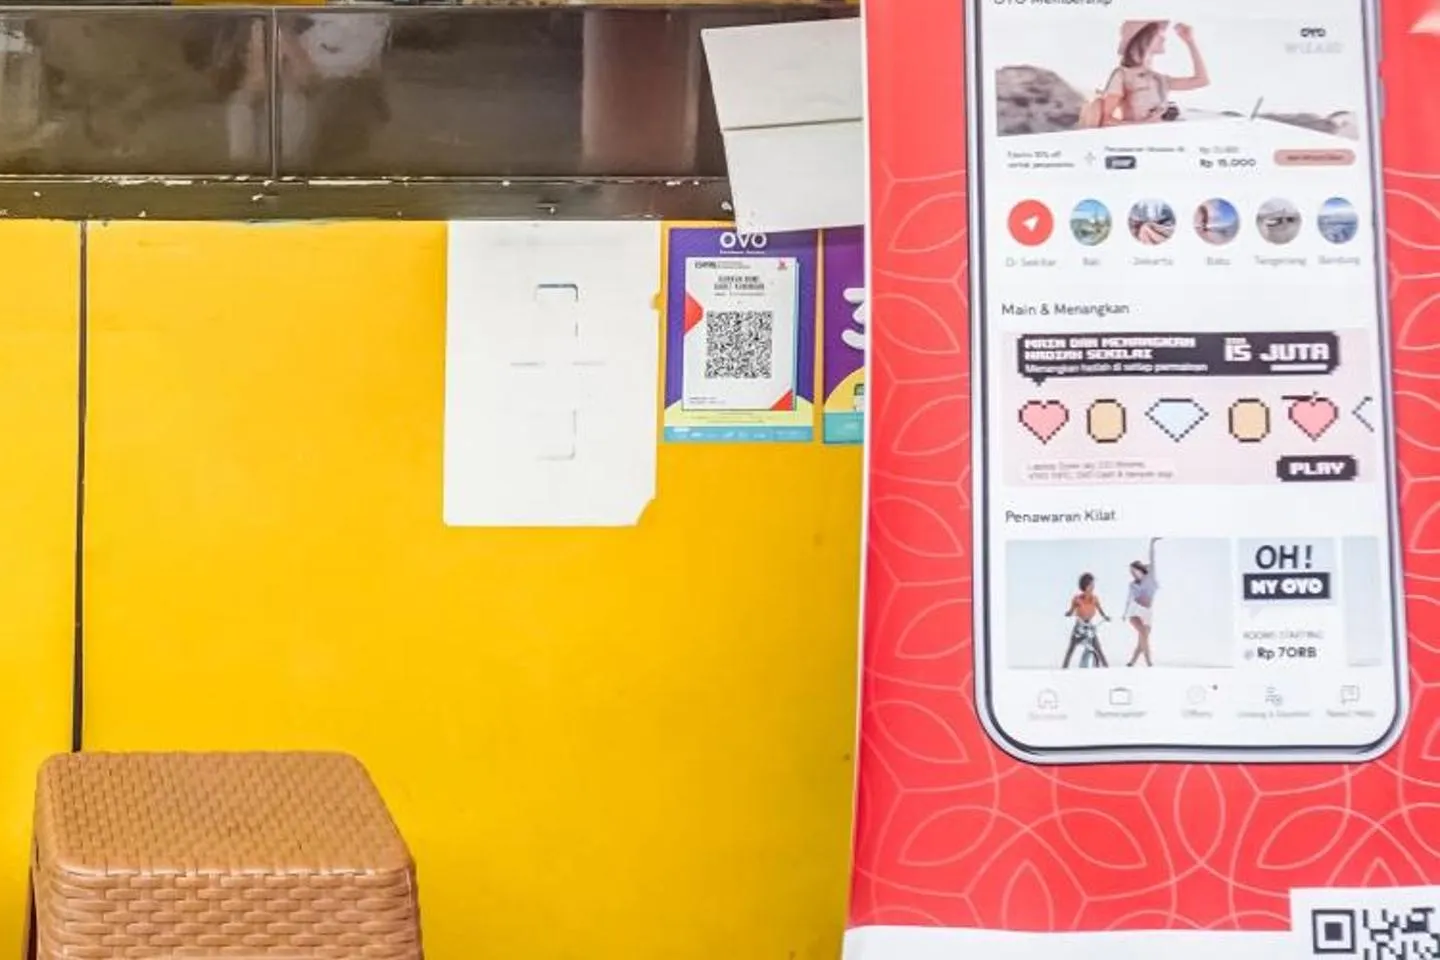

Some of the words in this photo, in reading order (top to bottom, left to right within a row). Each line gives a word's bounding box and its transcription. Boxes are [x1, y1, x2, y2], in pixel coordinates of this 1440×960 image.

[1300, 27, 1326, 38] OYO
[1001, 303, 1037, 316] Main
[1040, 303, 1050, 316] &
[1053, 302, 1130, 318] Menangkan
[1224, 344, 1252, 361] 15
[1259, 343, 1330, 361] JUTA
[1288, 461, 1345, 477] PLAY
[1005, 510, 1082, 524] Penawaran
[1085, 509, 1116, 523] Kilat
[1255, 544, 1312, 570] OH!
[1250, 579, 1278, 594] MY
[1281, 578, 1323, 594] OYO
[1257, 646, 1275, 660] Rp
[1278, 646, 1317, 658] 70RB
